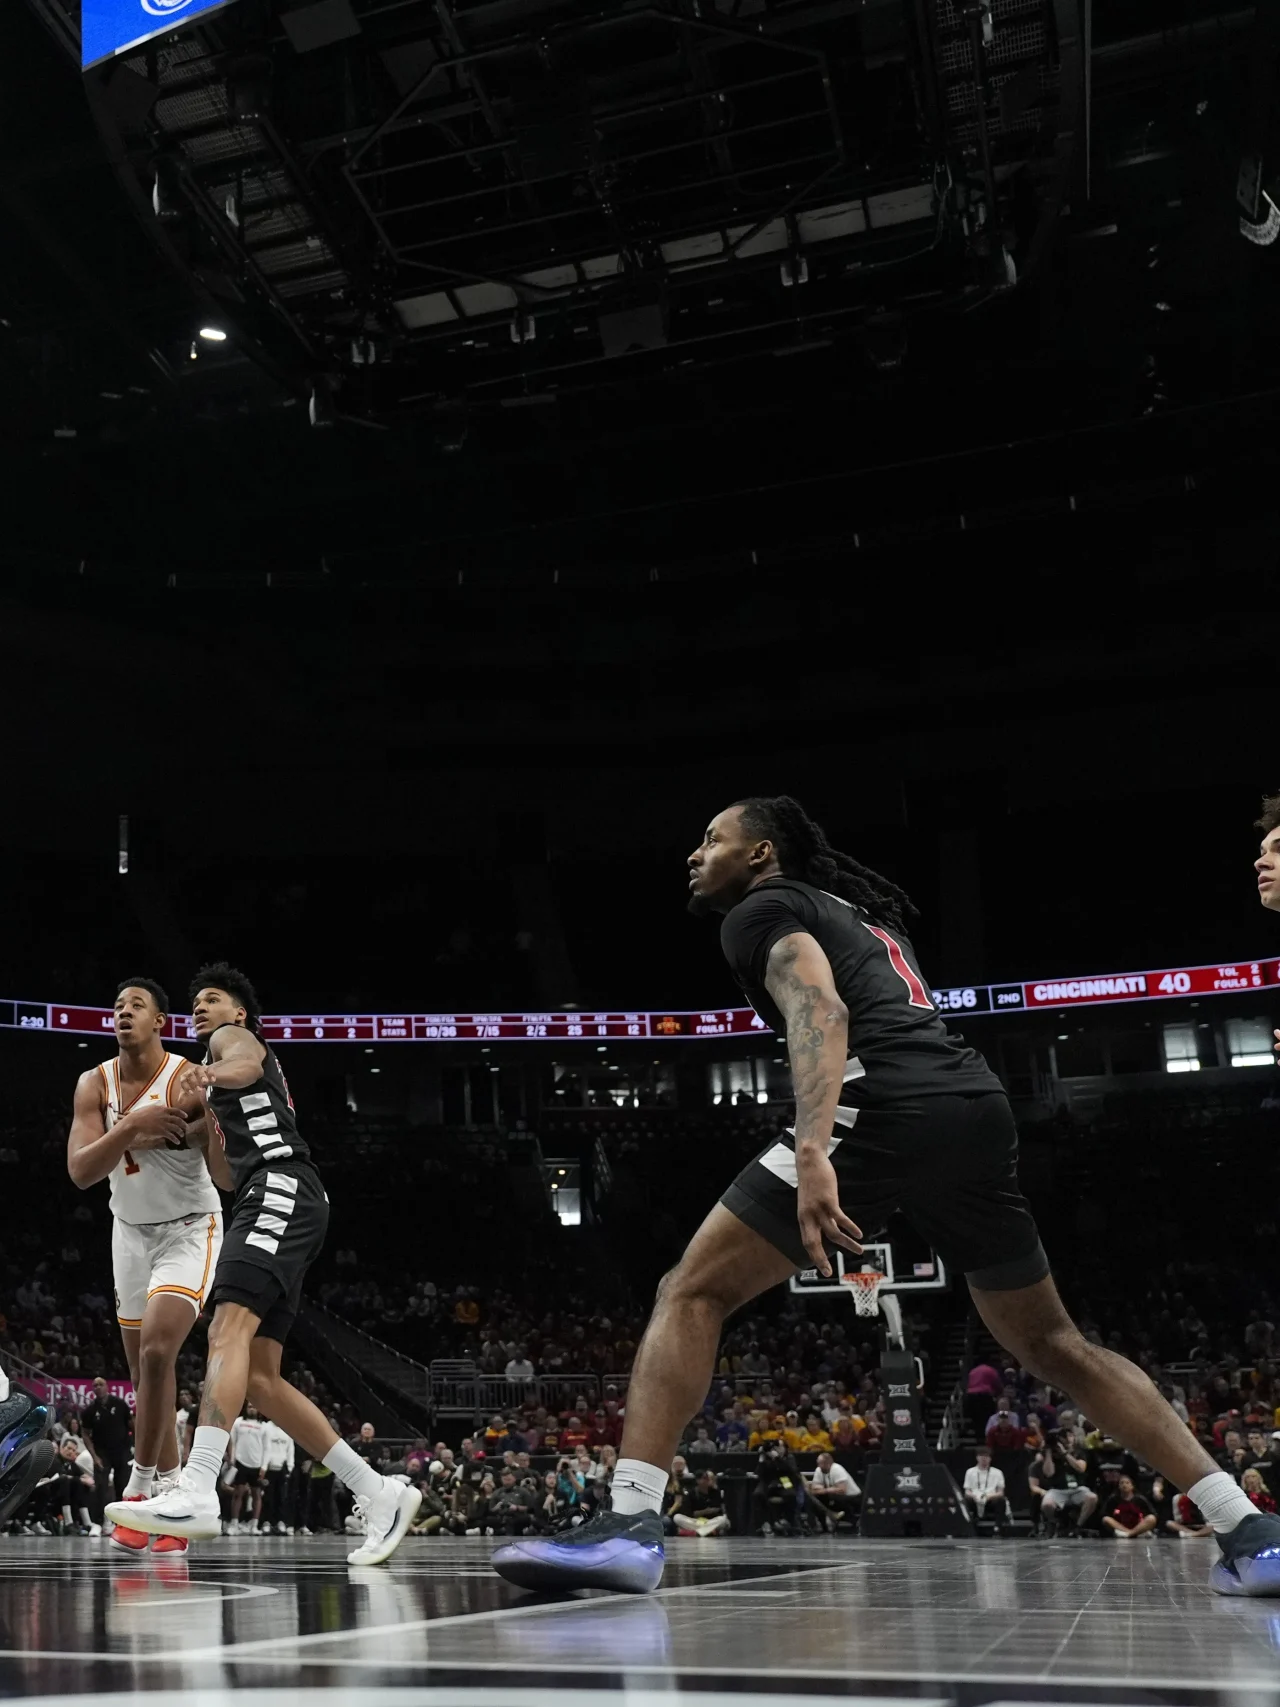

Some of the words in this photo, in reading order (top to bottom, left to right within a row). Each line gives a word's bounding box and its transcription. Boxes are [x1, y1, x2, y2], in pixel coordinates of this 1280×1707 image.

[860, 920, 935, 1010] 1
[1033, 976, 1146, 1001] CINCINNATI
[1158, 972, 1191, 994] 40
[1214, 978, 1248, 989] FOULS
[998, 993, 1020, 1004] 2ND
[60, 1013, 68, 1025] 3
[382, 1018, 405, 1027] TEAM
[283, 1028, 291, 1038] 2
[348, 1028, 356, 1038] 2
[381, 1029, 407, 1037] STATS
[476, 1026, 500, 1037] 7/15
[527, 1026, 547, 1037] 2/2
[567, 1025, 583, 1036] 25
[628, 1024, 640, 1036] 12
[696, 1024, 725, 1034] FOULS
[67, 1384, 136, 1408] Moile
